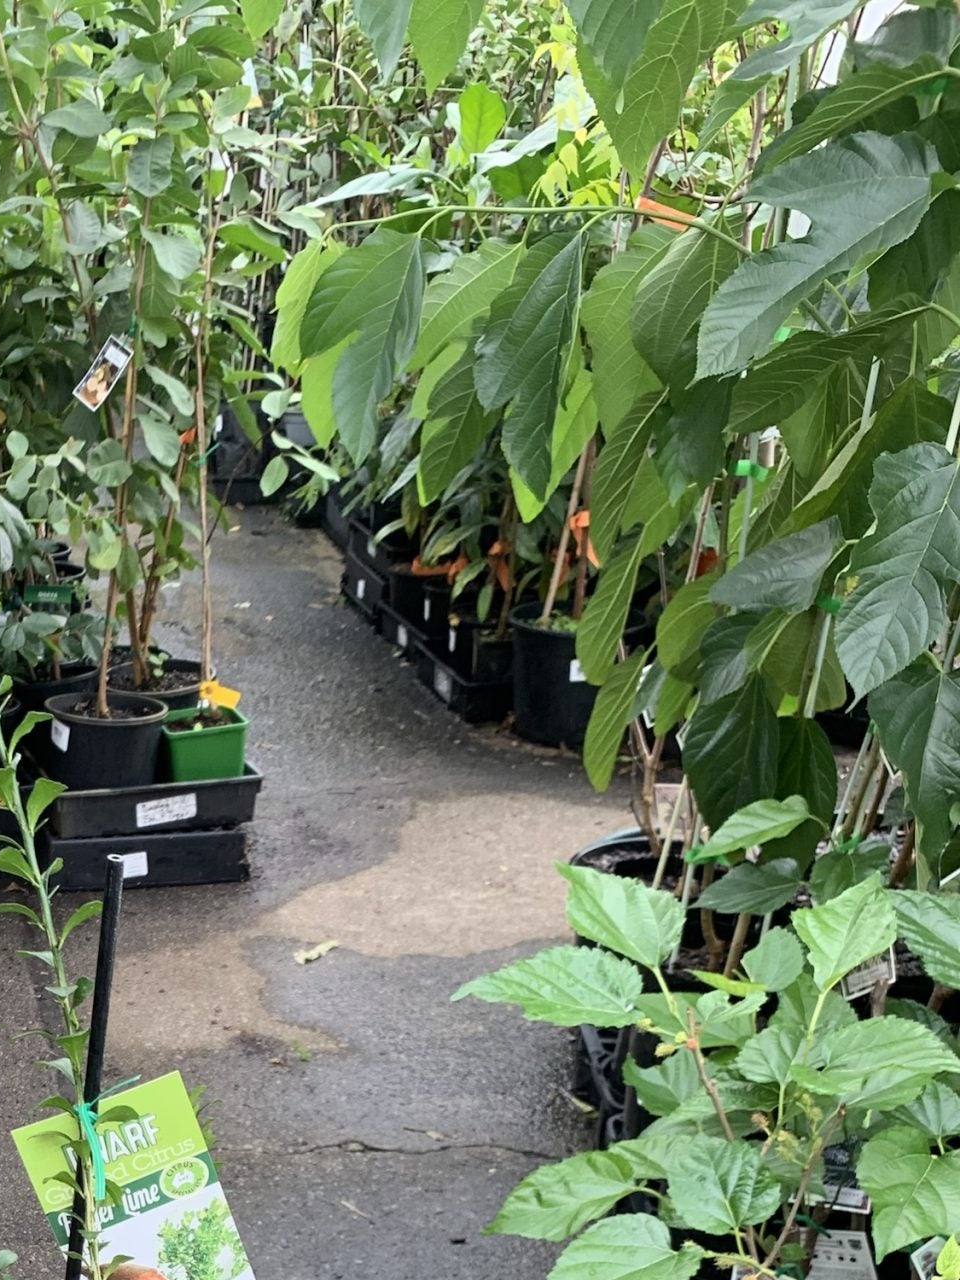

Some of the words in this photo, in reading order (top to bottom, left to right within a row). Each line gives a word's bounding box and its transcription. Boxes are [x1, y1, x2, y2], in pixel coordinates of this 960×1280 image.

[63, 1114, 159, 1172] DARF
[132, 1138, 196, 1173] Citrus
[166, 1161, 193, 1177] CITRUS
[57, 1203, 115, 1238] Fger
[123, 1183, 161, 1216] Lime
